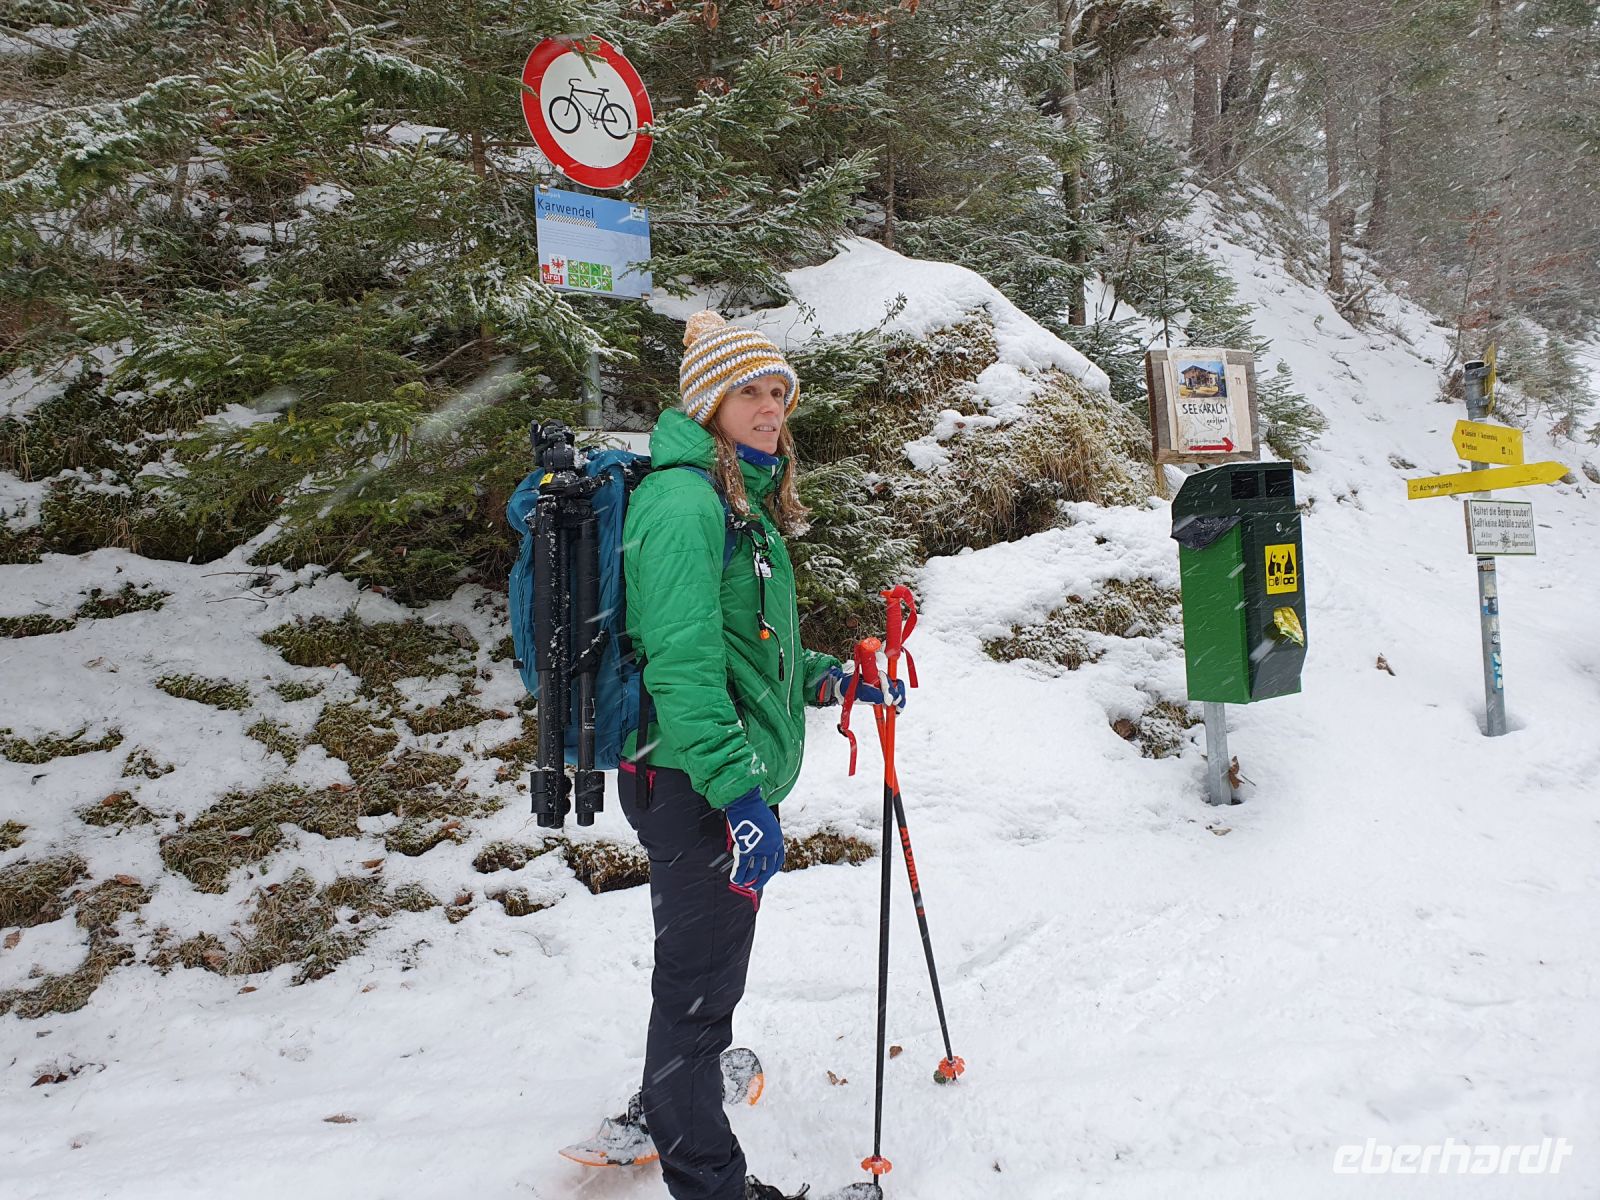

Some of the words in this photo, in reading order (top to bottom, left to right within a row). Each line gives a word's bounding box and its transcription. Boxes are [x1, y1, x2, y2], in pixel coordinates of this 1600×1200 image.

[537, 197, 594, 219] Karwendel
[543, 272, 561, 283] tirol
[1489, 507, 1497, 516] die
[1497, 506, 1511, 518] Berge
